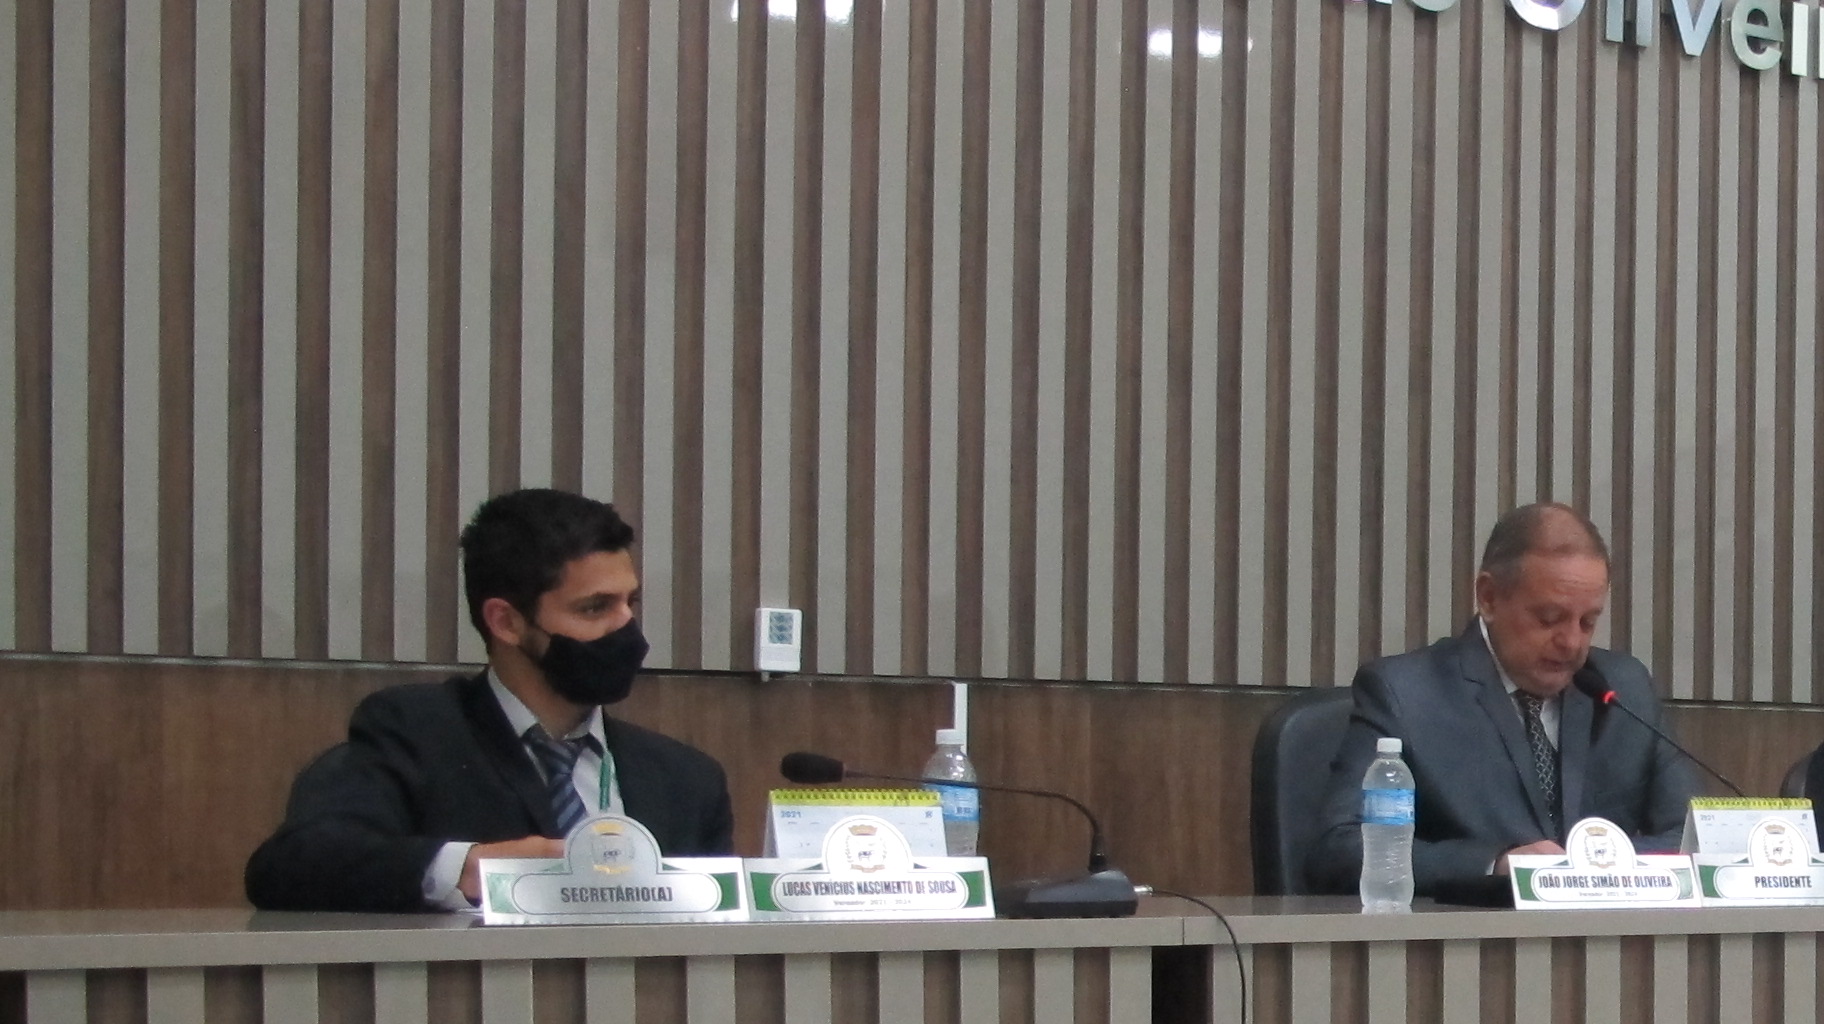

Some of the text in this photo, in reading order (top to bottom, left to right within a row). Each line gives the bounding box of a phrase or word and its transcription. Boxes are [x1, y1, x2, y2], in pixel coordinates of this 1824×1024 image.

[782, 881, 812, 896] LUCAS
[857, 880, 914, 895] NASCIMENTO
[915, 881, 925, 894] DE
[927, 880, 957, 894] SOUSA
[1538, 873, 1673, 888] JOÃO JORGE SIMÃO DE OLIVEIRA
[1754, 875, 1812, 888] PRESIDENTE
